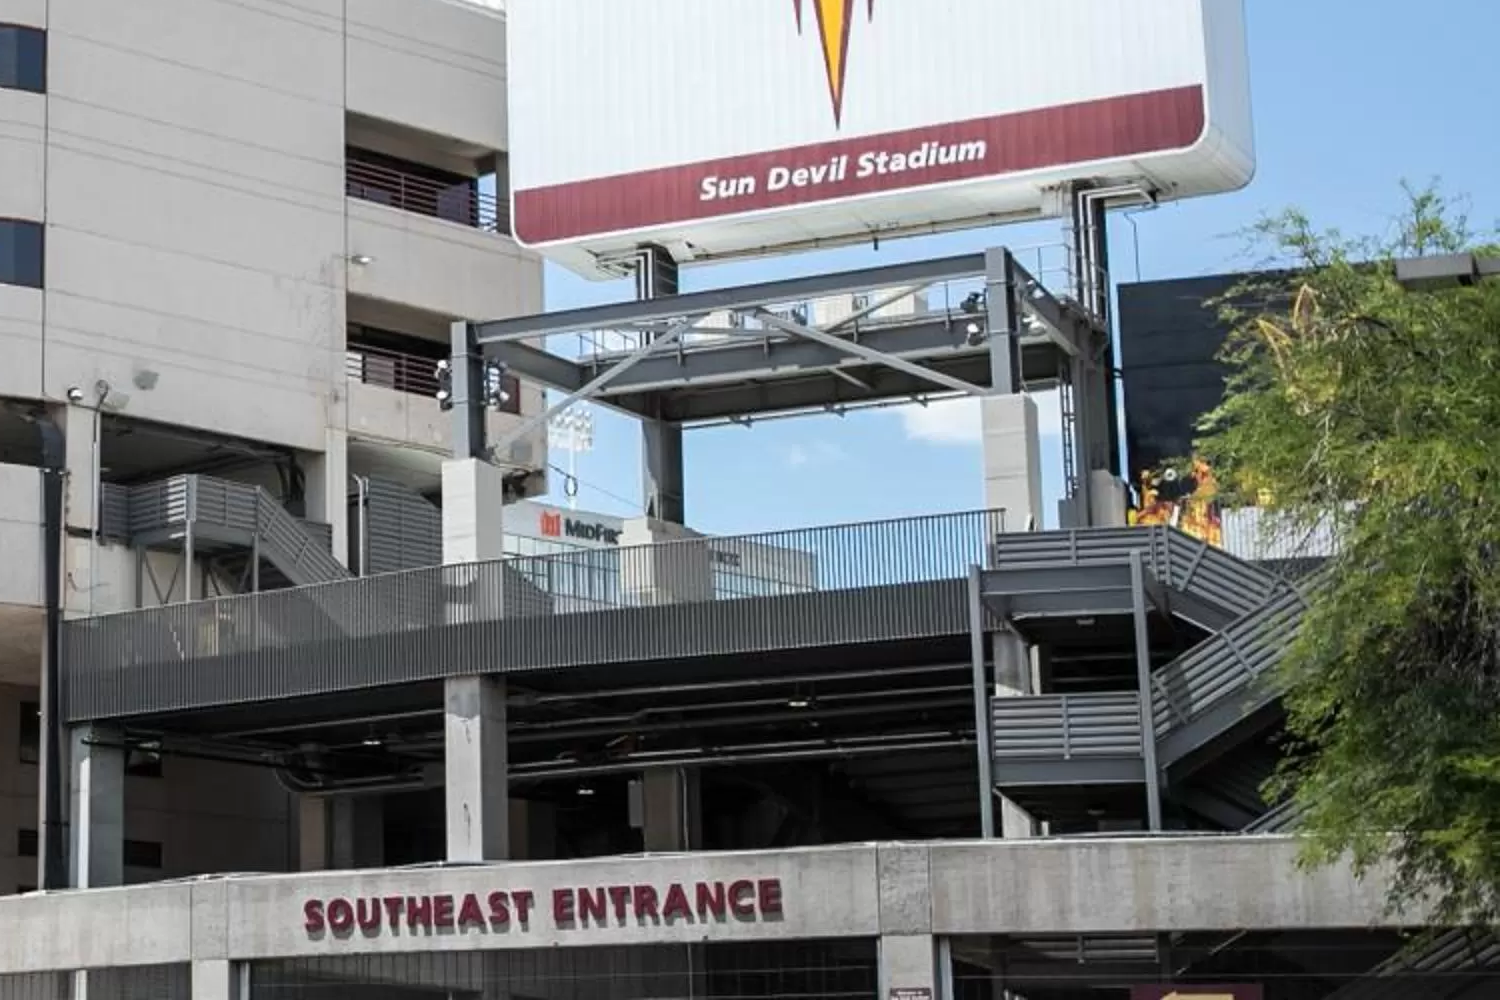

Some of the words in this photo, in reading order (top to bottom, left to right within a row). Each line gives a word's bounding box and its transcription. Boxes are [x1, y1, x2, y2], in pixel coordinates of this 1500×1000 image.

[700, 175, 756, 201] Sun
[767, 157, 848, 191] Devil
[856, 140, 987, 177] Stadium
[304, 890, 534, 932] SOUTHEAST
[552, 879, 784, 921] ENTRANCE
